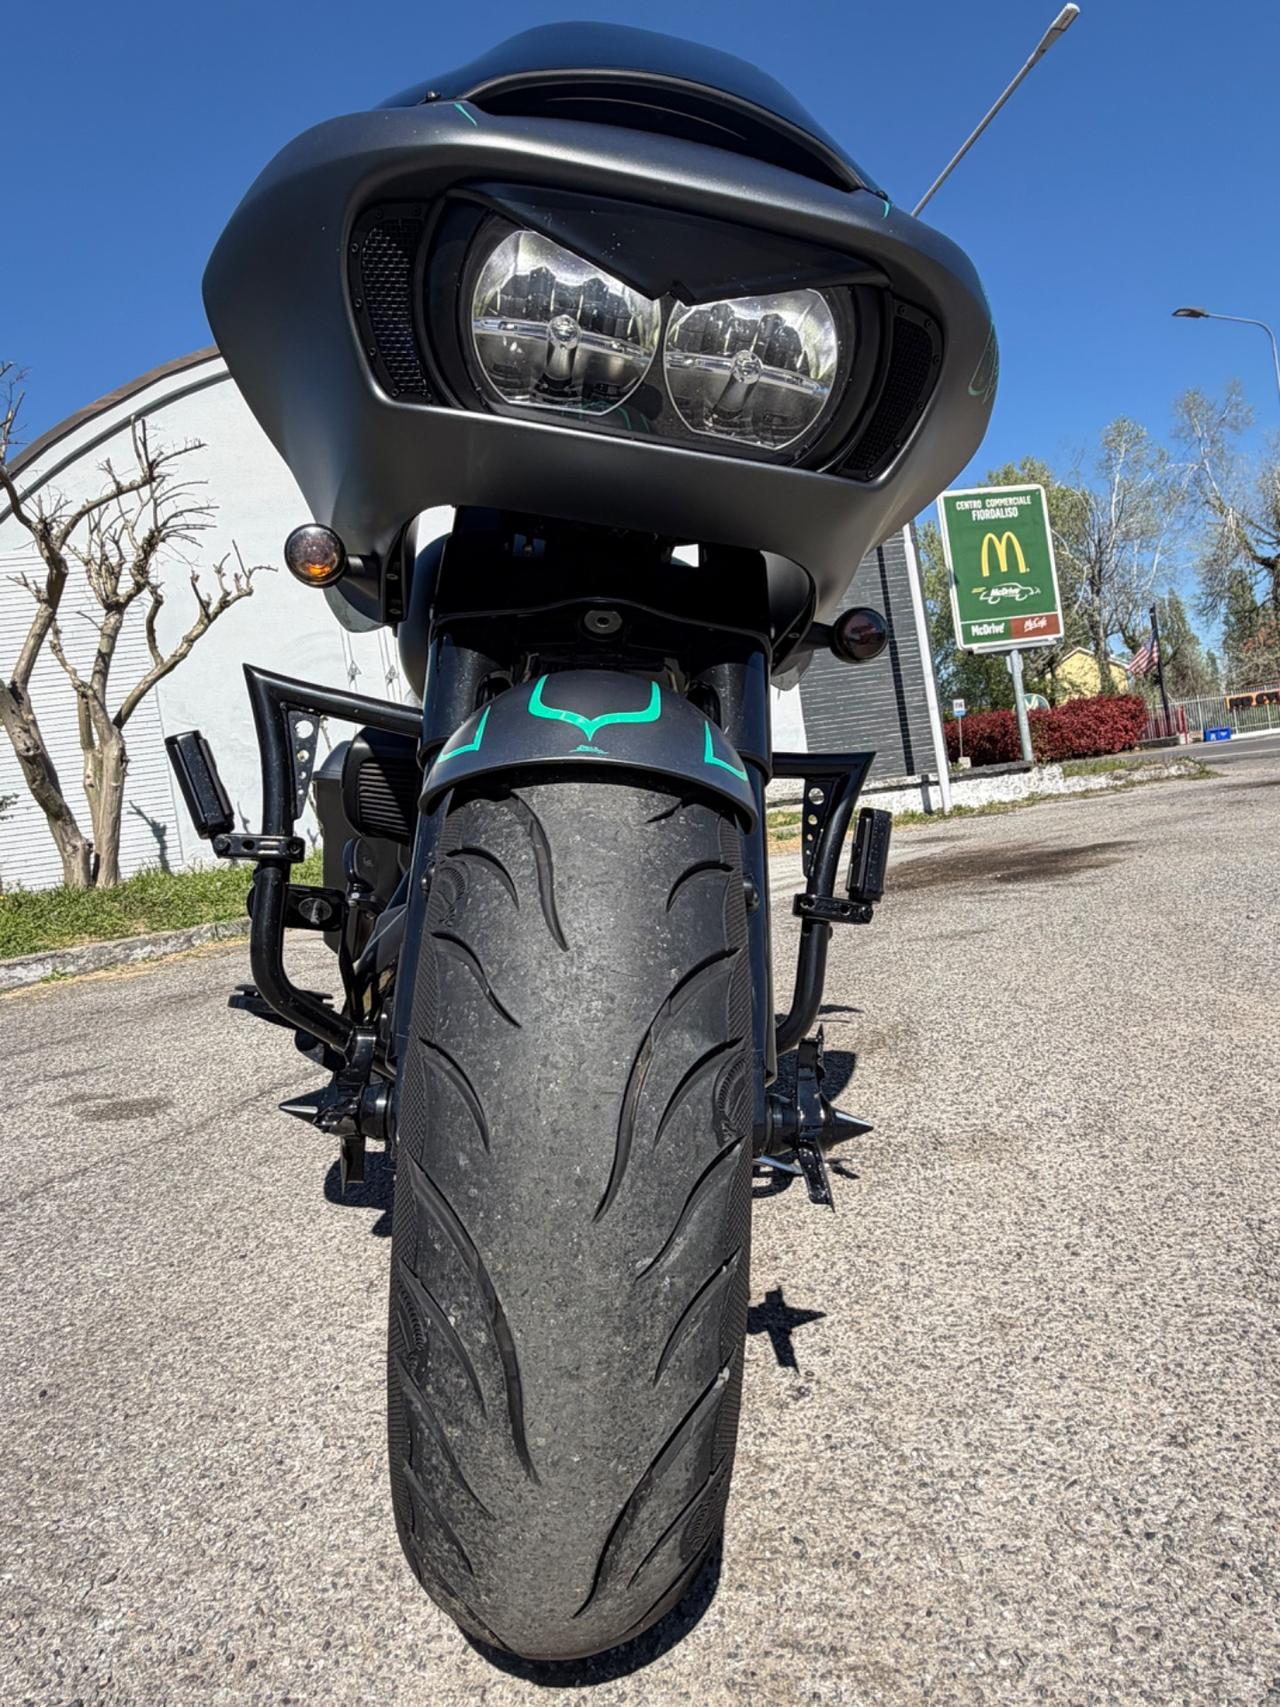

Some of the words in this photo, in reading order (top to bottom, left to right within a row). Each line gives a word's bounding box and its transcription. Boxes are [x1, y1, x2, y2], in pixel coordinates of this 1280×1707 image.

[956, 500, 982, 510] CENTRO
[985, 496, 1032, 507] COMMERCIALE
[972, 507, 1018, 520] FIORDALISO
[971, 622, 1005, 636] McDrive
